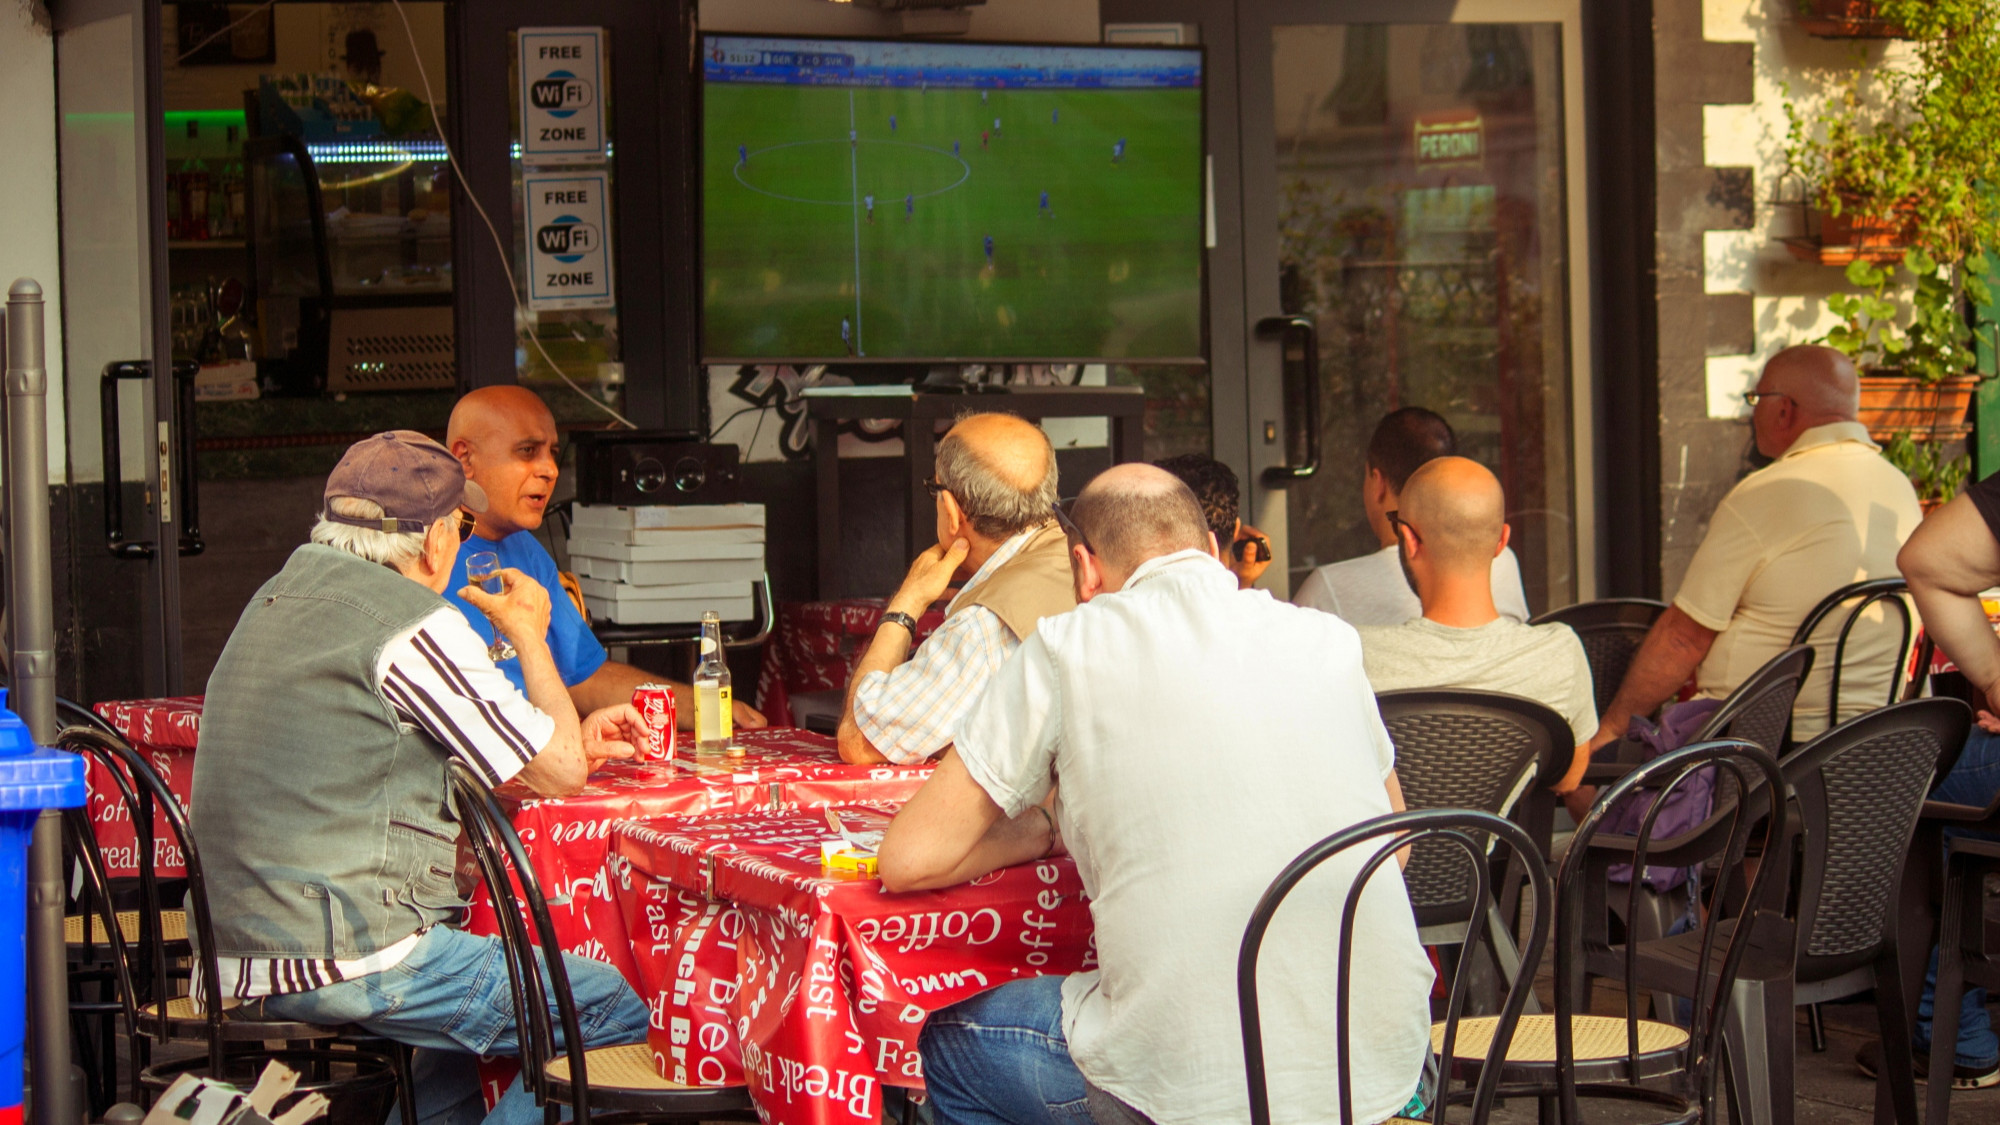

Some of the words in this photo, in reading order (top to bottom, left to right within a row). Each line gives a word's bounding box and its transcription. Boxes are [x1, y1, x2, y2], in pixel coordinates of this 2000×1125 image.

[539, 46, 582, 60] FREE
[535, 84, 583, 104] WiFi
[539, 128, 587, 142] ZONE
[1419, 131, 1479, 160] PERONI
[544, 191, 588, 205] FREE
[541, 229, 589, 250] WiFi
[546, 272, 594, 287] ZONE
[550, 818, 613, 843] ner
[100, 836, 140, 869] rea
[153, 837, 187, 869] Fas
[646, 880, 673, 957] Fast
[857, 908, 1002, 953] Coffee
[1019, 864, 1060, 976] offee
[672, 904, 722, 1006] unch
[738, 914, 786, 1042] Dinne
[805, 934, 838, 1023] Fast
[900, 968, 988, 996] Lunc
[697, 977, 739, 1086] Brea
[670, 1016, 691, 1086] Bre
[875, 1036, 923, 1079] Fa
[779, 1057, 877, 1120] Break
